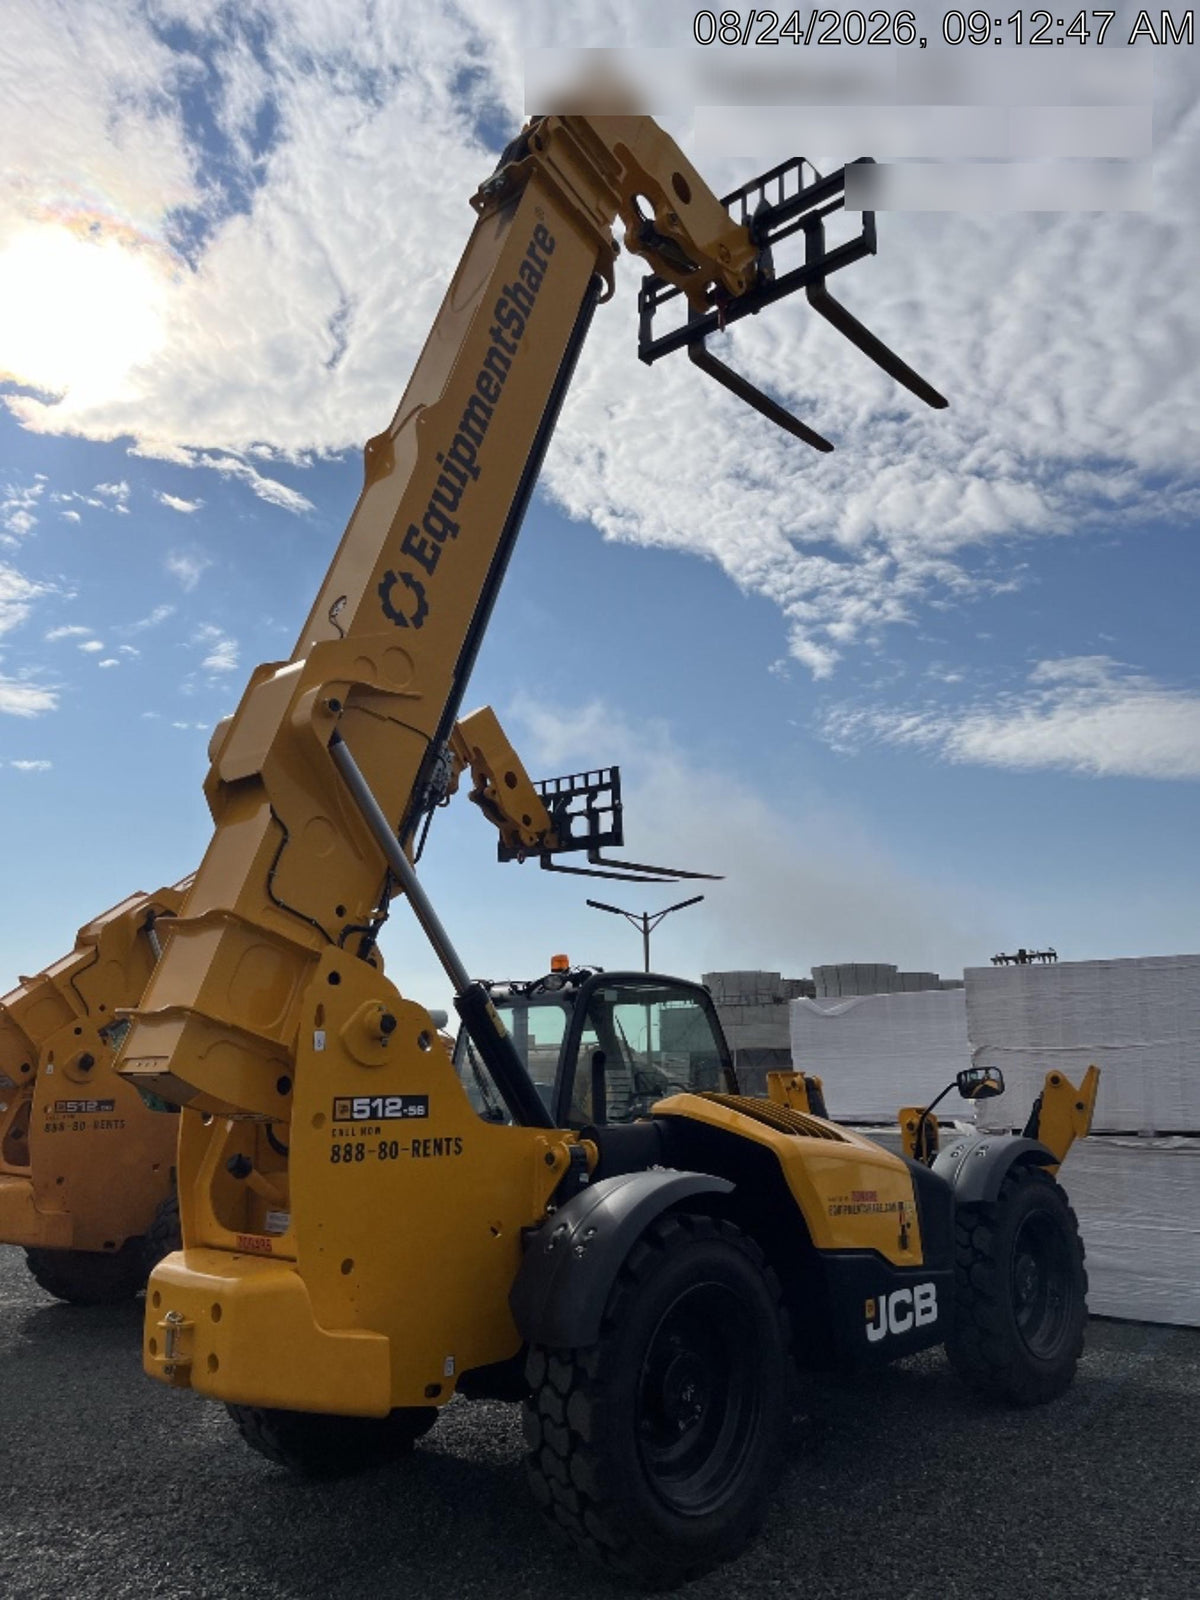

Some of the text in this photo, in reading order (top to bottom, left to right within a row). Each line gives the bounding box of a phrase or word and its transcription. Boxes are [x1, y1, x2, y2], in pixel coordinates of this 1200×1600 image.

[399, 221, 556, 577] EquipmentShare
[66, 1101, 113, 1112] 512-
[330, 1137, 463, 1163] 888-80-RENTS
[866, 1282, 938, 1341] JCB
